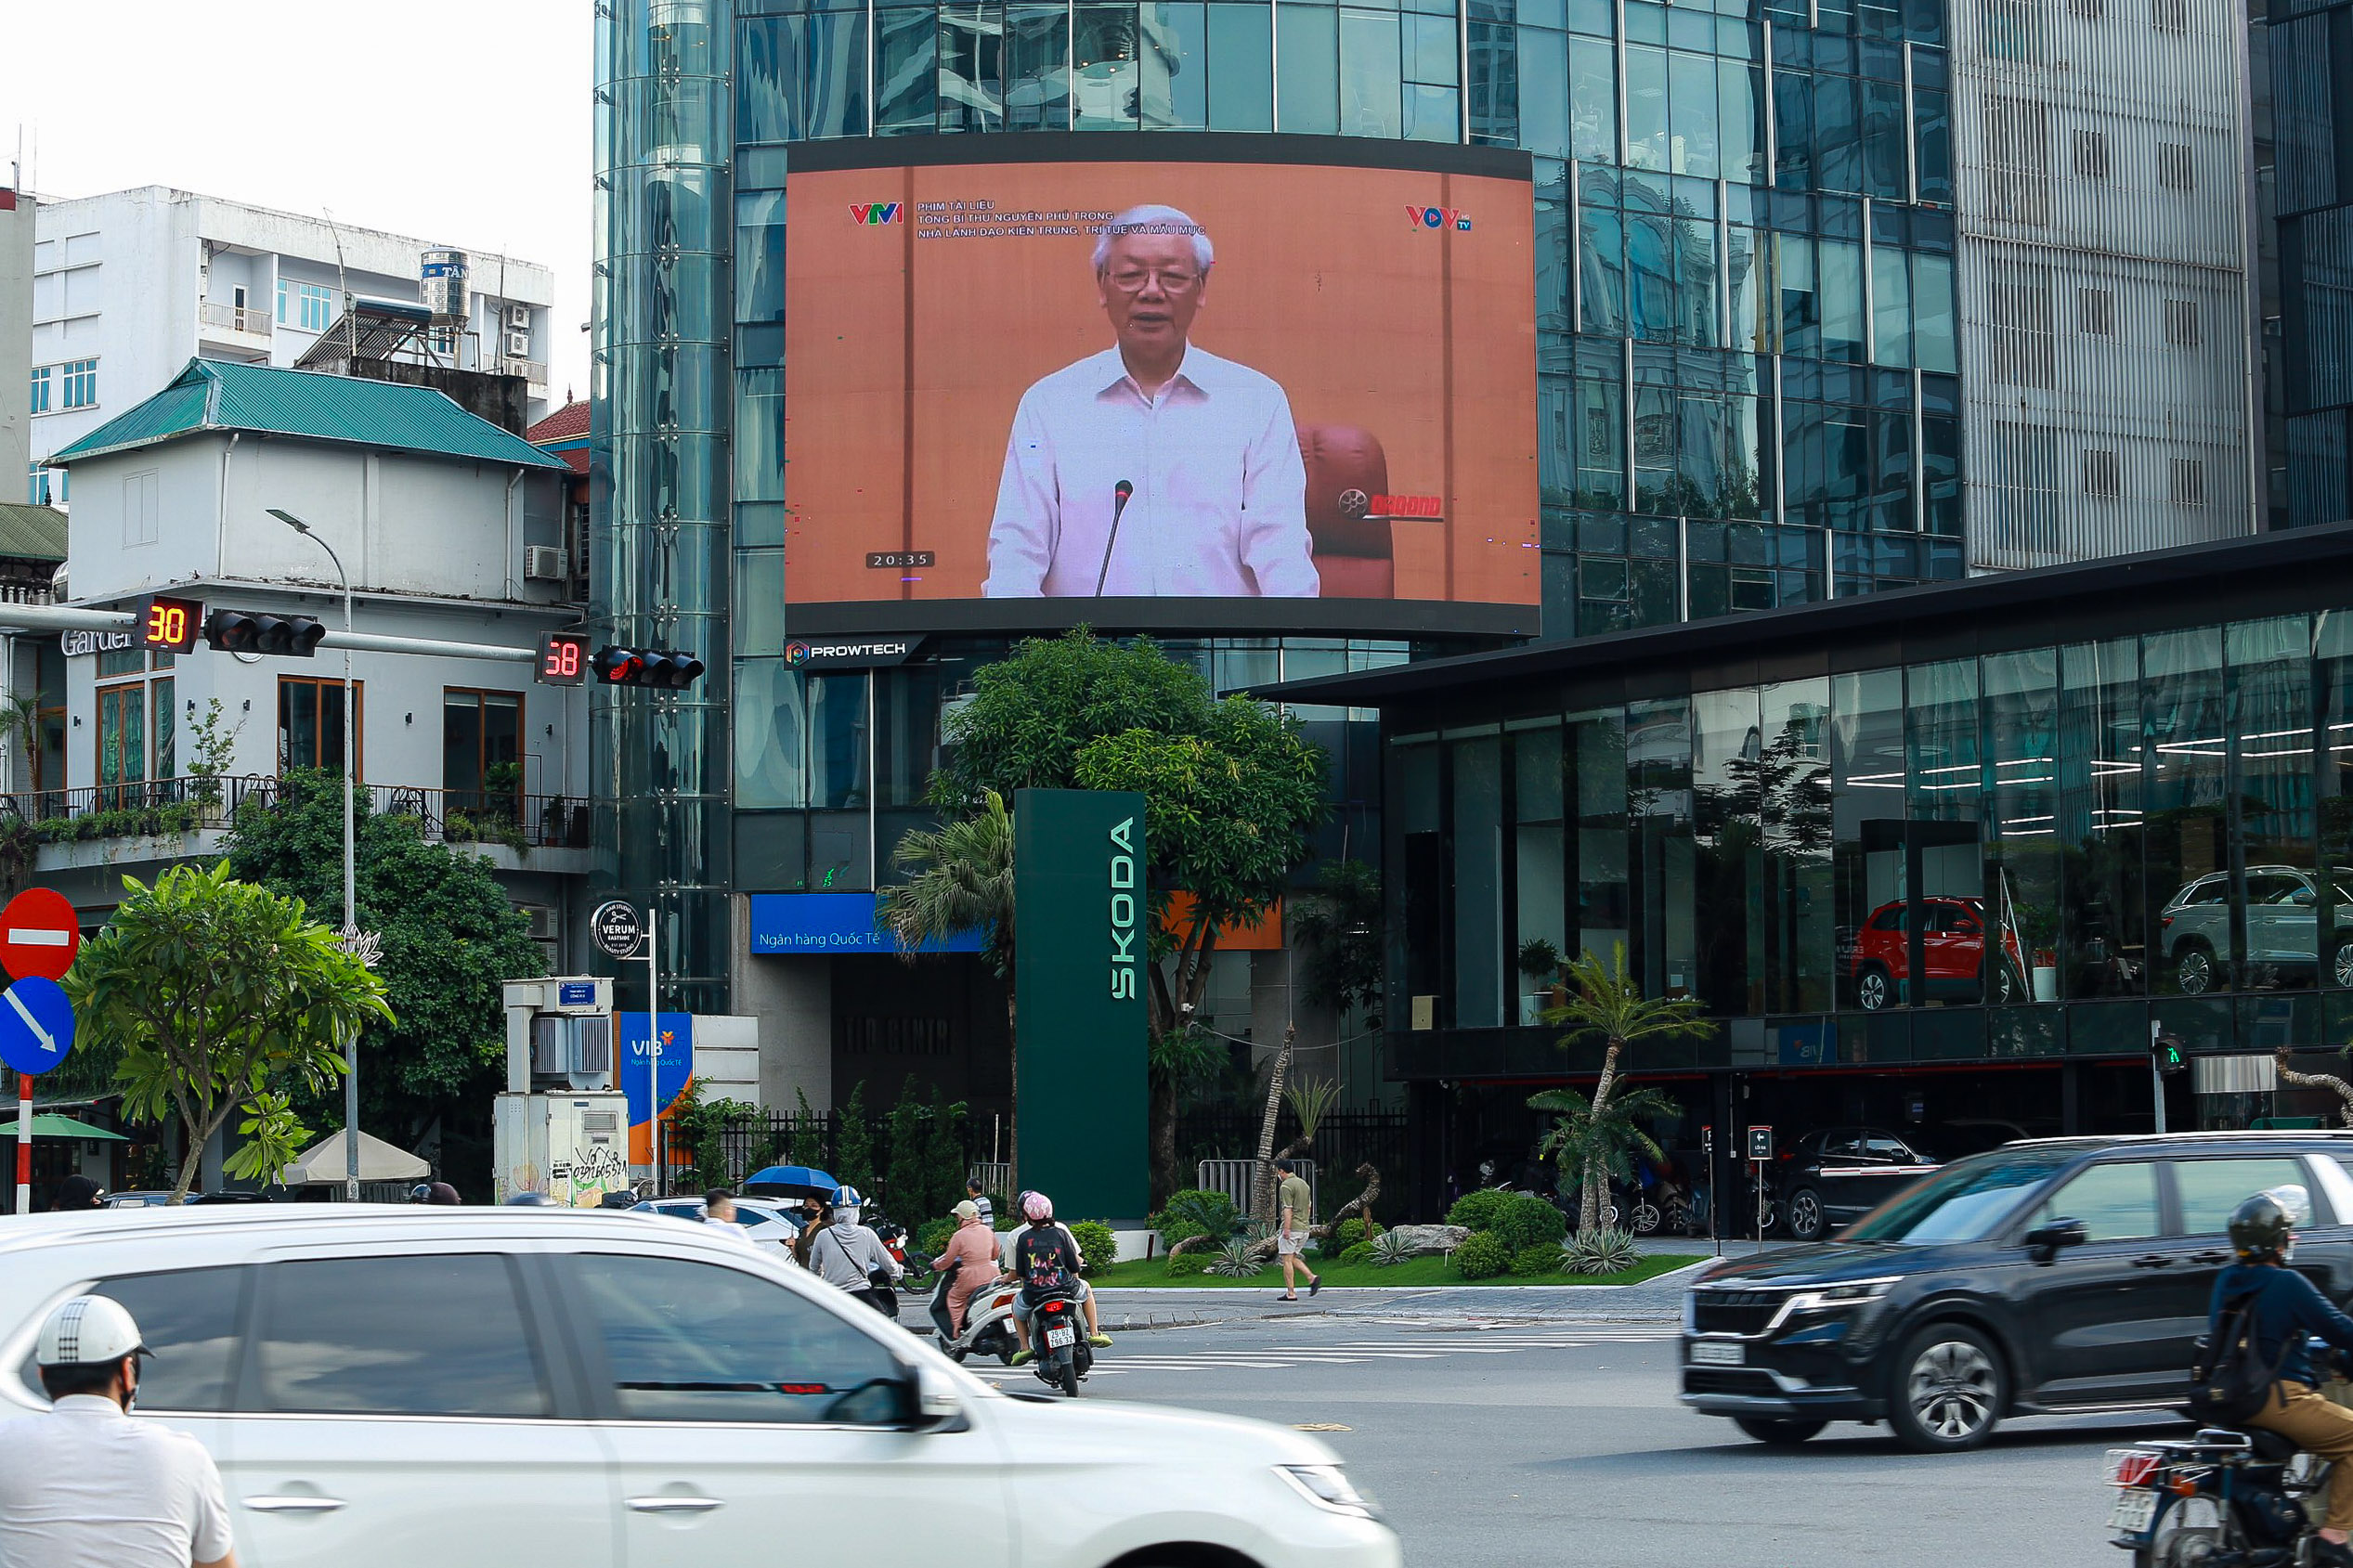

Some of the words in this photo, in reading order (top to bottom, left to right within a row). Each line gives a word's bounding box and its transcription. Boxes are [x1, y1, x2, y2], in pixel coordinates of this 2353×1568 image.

[917, 201, 945, 212] PHIM
[948, 200, 966, 211] TÀI
[969, 200, 994, 211] LIỆU
[953, 213, 964, 224] BÍ
[968, 213, 992, 224] THƯ
[1046, 210, 1070, 221] PHÚ
[1073, 211, 1113, 222] TRỌNG
[918, 227, 942, 239] NHÀ
[979, 227, 1005, 239] ĐẠO
[1037, 226, 1081, 236] TRUNG,
[1084, 224, 1103, 235] TRÍ
[1105, 225, 1128, 236] TUỆ
[1130, 223, 1147, 234] VÀ
[1178, 225, 1206, 236] MỰC
[1458, 221, 1470, 229] TV
[874, 554, 928, 566] 20:35
[147, 606, 185, 643] 30
[811, 643, 906, 657] PROWTECH
[603, 925, 635, 934] VERUM
[760, 934, 792, 949] Ngân
[795, 933, 826, 948] hàng
[829, 931, 863, 946] Quốc
[631, 1040, 663, 1056] VIB
